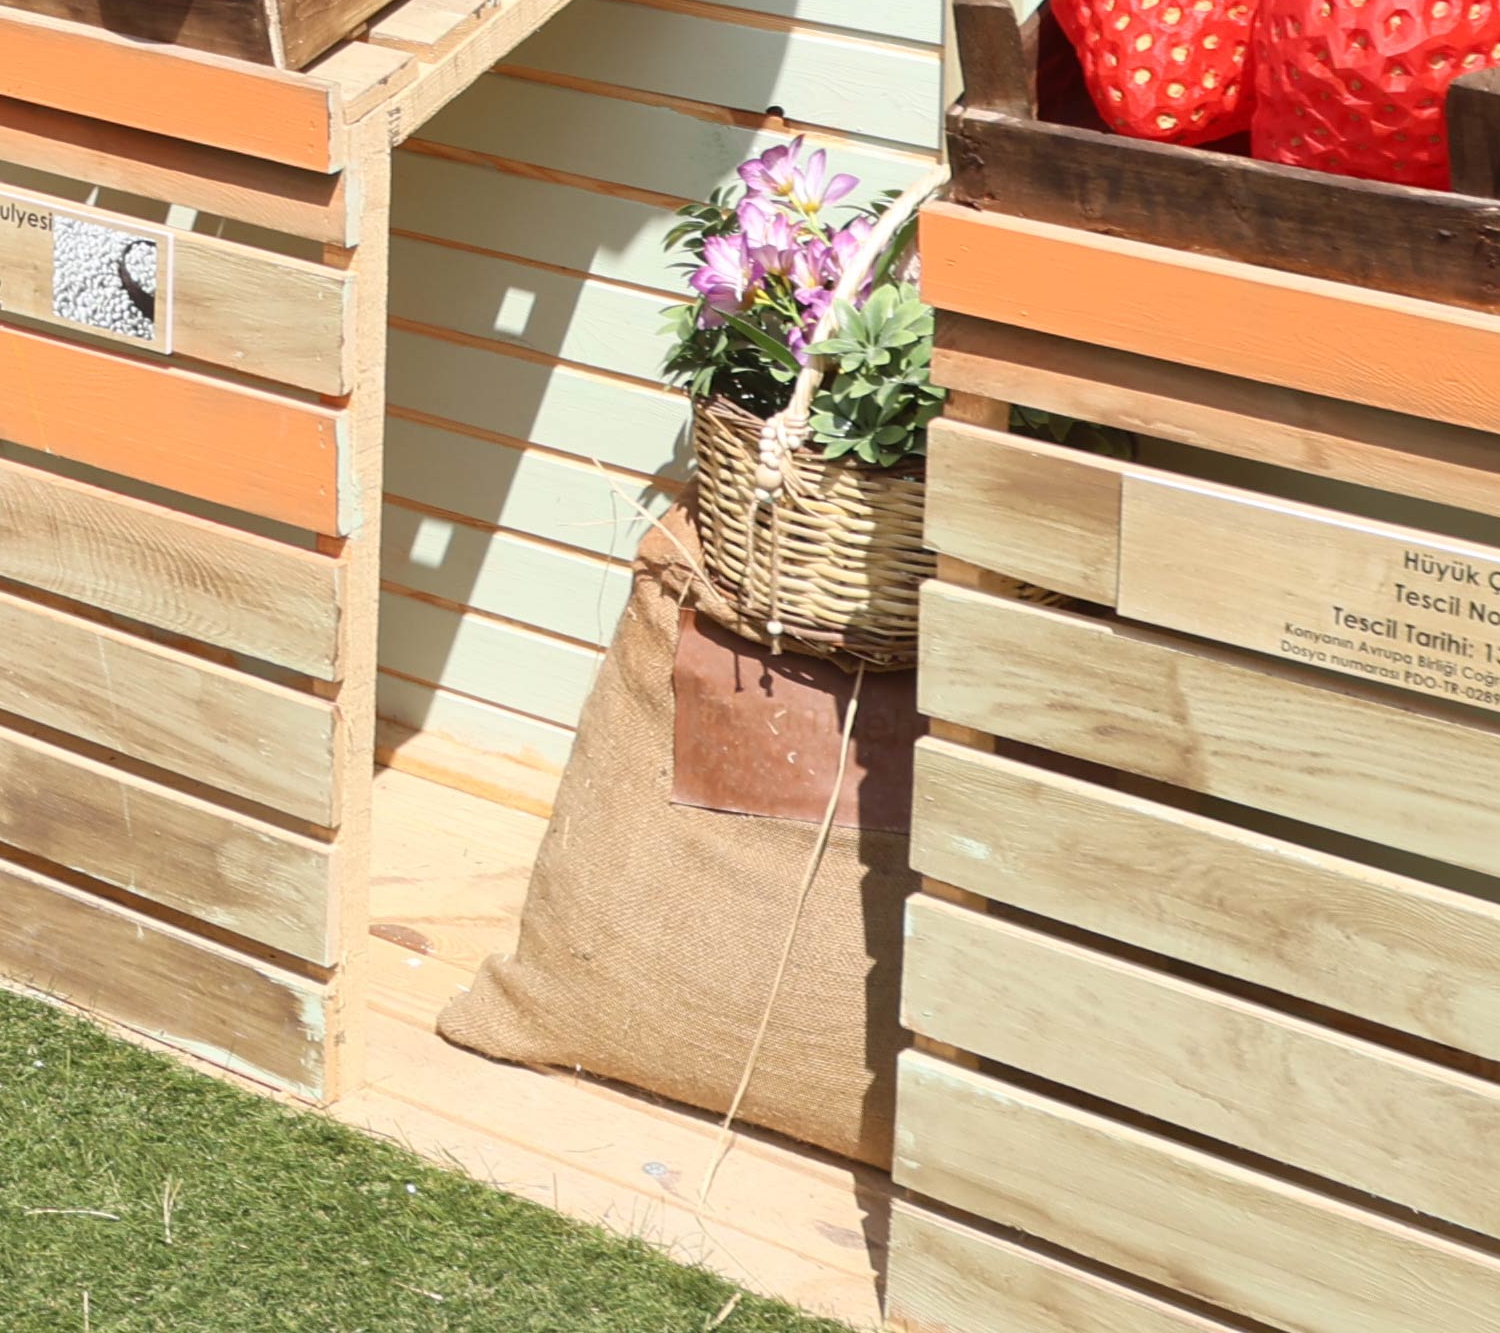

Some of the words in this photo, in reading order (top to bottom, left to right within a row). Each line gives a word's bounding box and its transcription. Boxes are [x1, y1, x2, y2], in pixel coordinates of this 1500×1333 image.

[1403, 550, 1480, 586] Hüyük
[1394, 583, 1461, 617] Tescil
[1284, 622, 1354, 650] Konyanın
[1358, 641, 1413, 666] Avrupa
[1417, 654, 1458, 678] Birliği
[1332, 605, 1399, 640] Tescil
[1404, 623, 1475, 659] Tarihi:
[1280, 639, 1327, 664] Dosya
[1330, 653, 1400, 681] numarası
